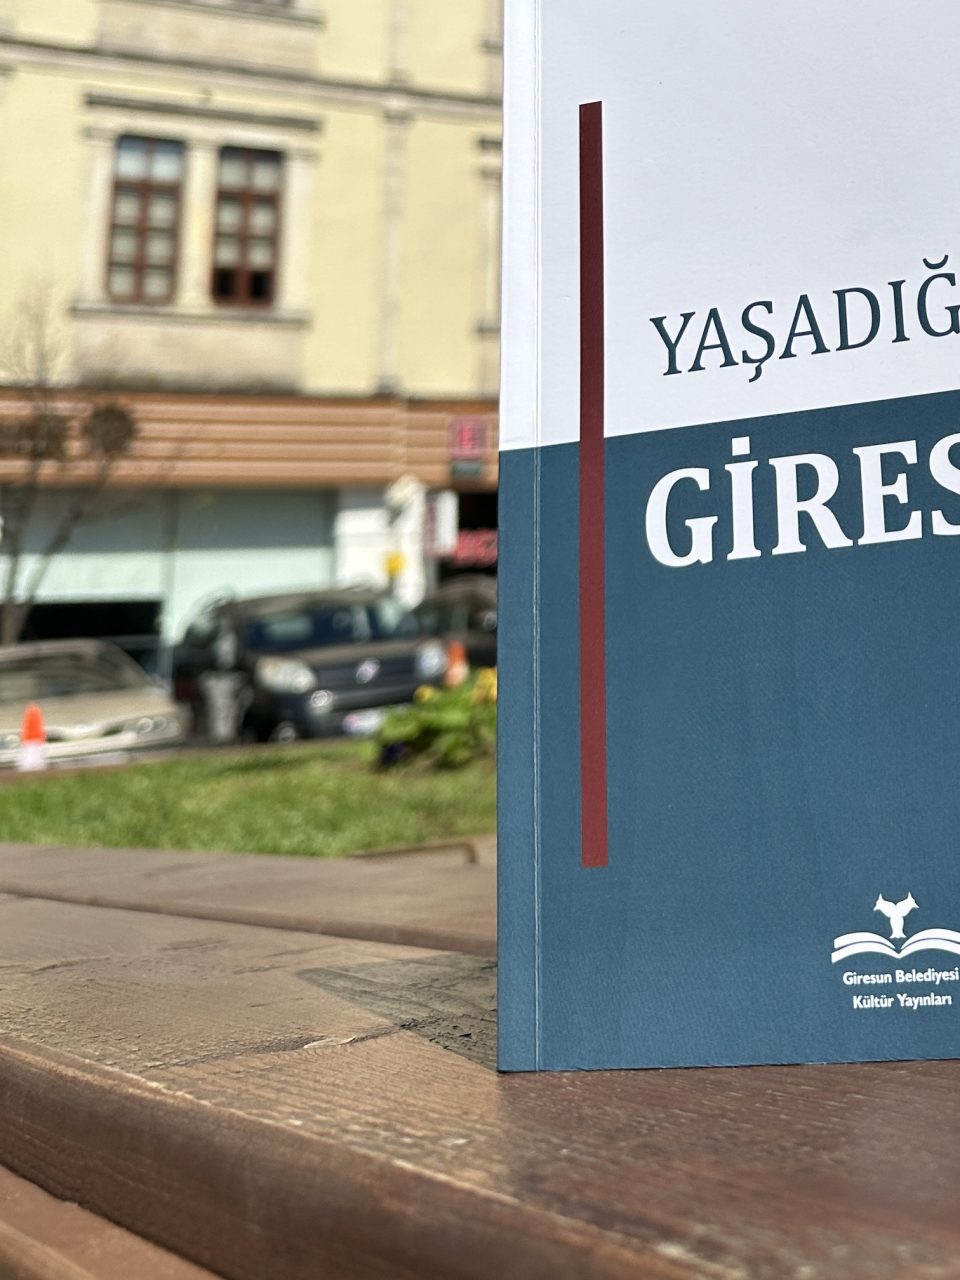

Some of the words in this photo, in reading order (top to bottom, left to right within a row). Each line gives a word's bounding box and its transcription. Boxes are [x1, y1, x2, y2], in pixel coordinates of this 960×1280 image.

[843, 971, 892, 985] Giresun
[895, 967, 960, 985] Belediyesi
[853, 994, 895, 1009] Kültür
[896, 993, 952, 1010] Yayınları
